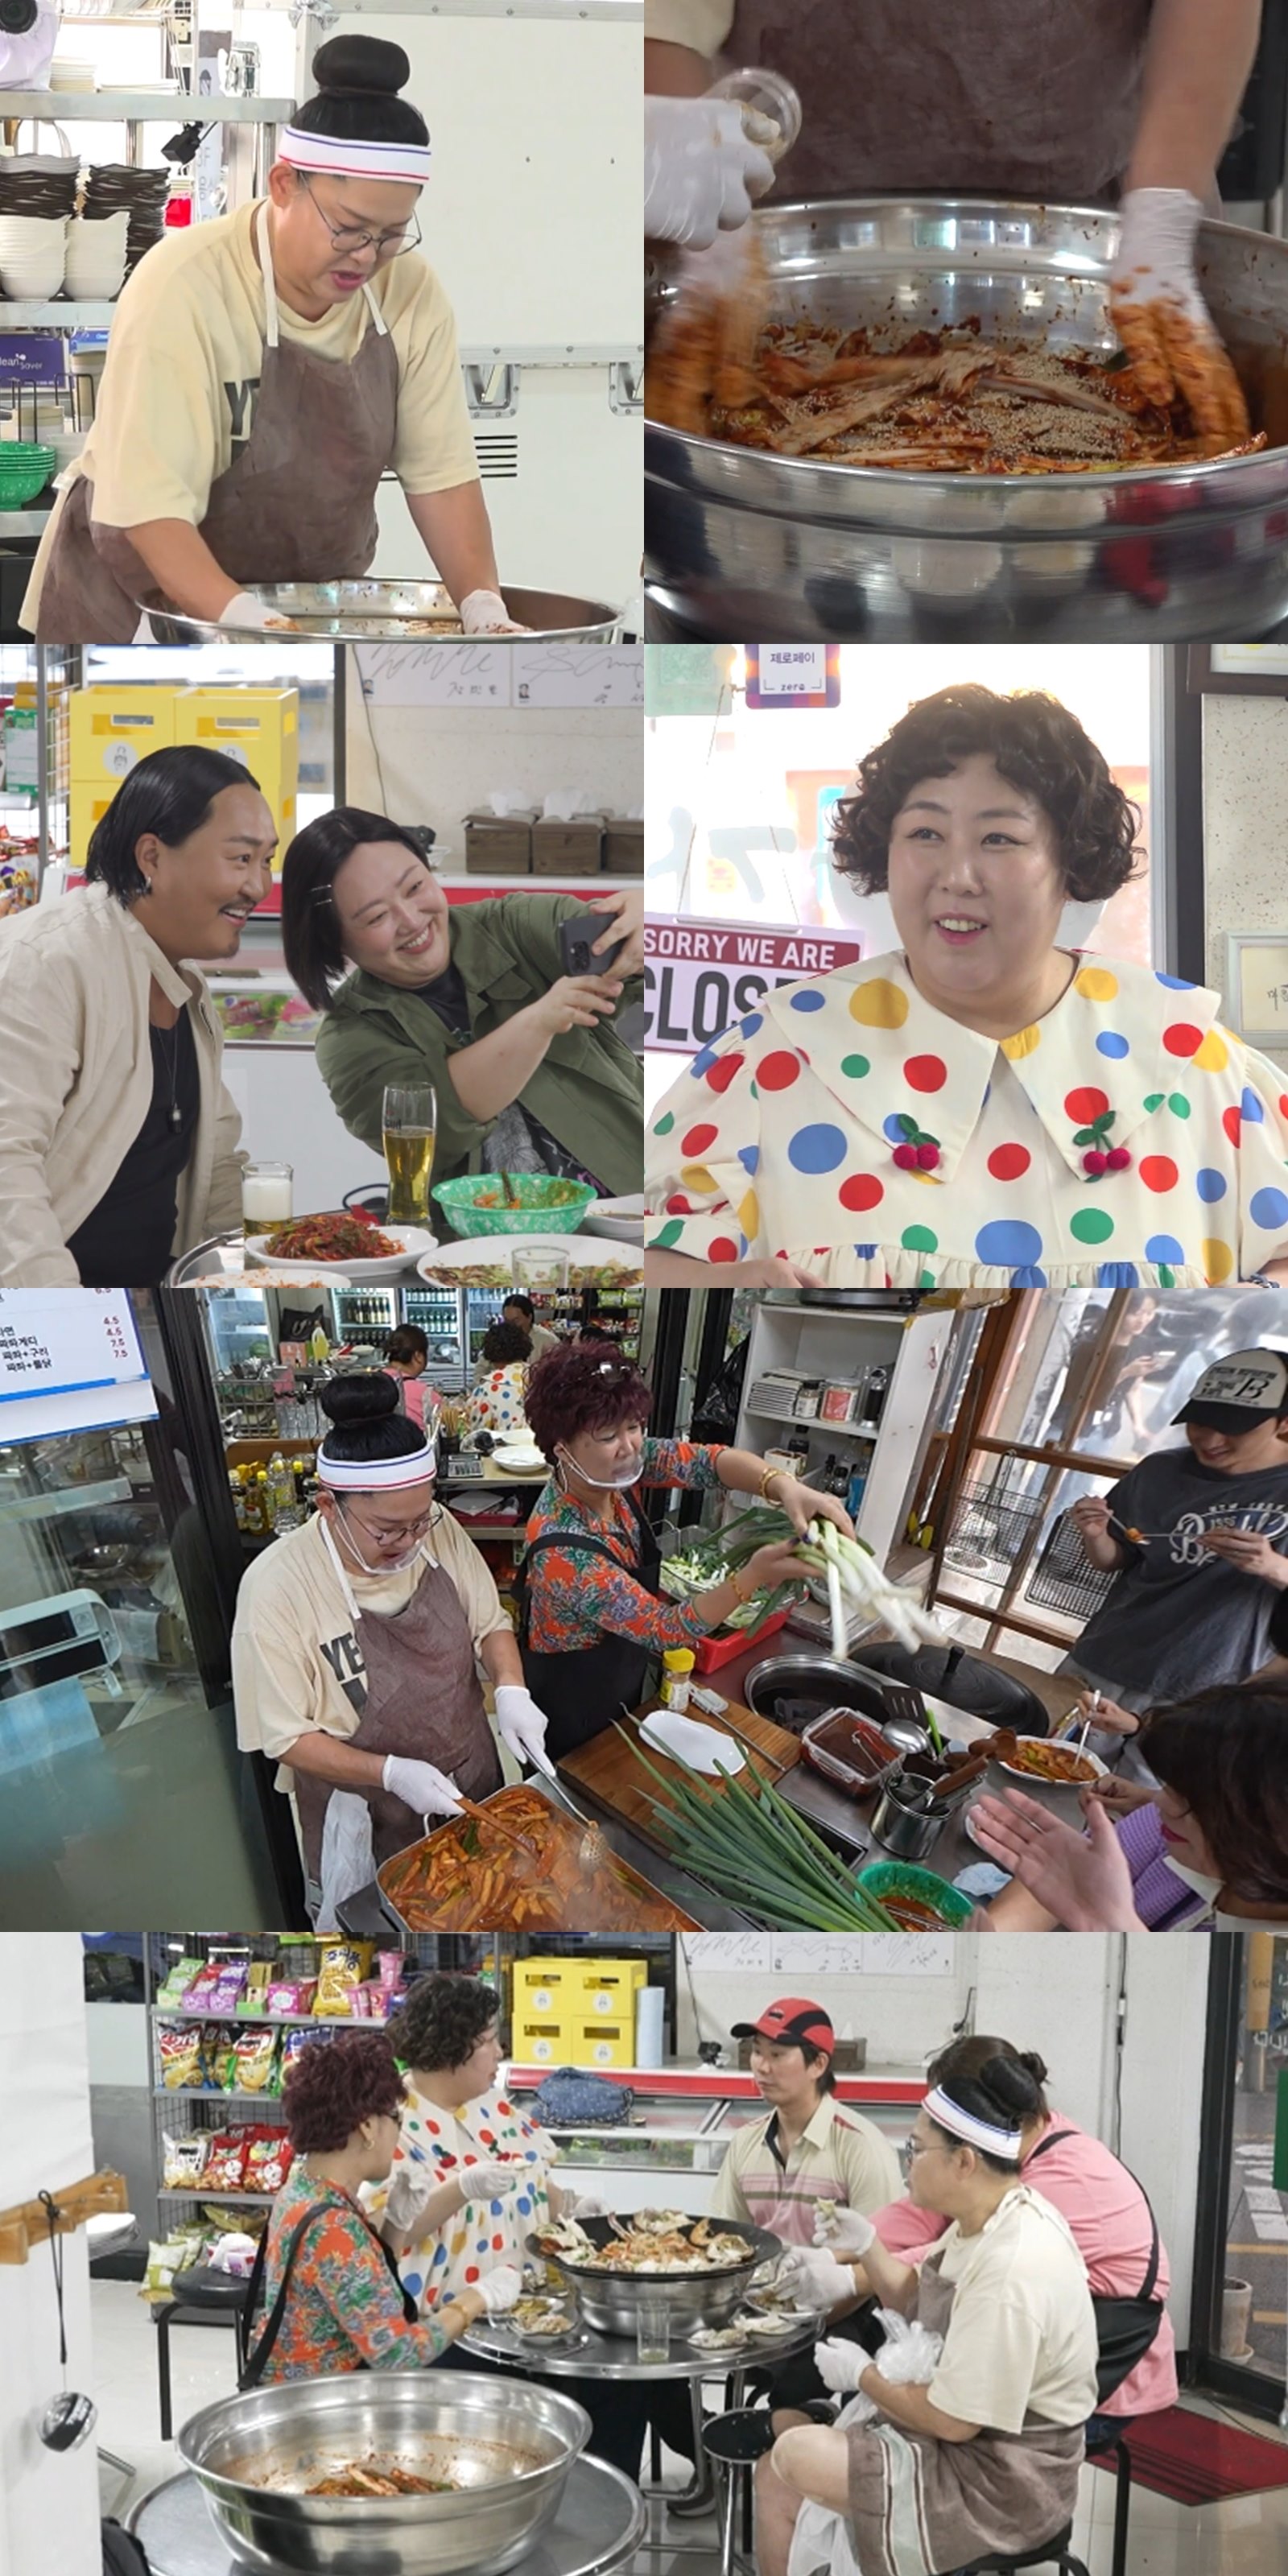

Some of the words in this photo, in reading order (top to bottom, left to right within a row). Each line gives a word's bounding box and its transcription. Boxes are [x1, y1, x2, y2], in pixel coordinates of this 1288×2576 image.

[770, 651, 815, 664] 제로페이
[644, 928, 729, 960] SORRY
[737, 937, 775, 964] WE
[781, 942, 836, 969] ARE
[104, 1316, 119, 1325] 4.5
[114, 1350, 128, 1358] 7.5
